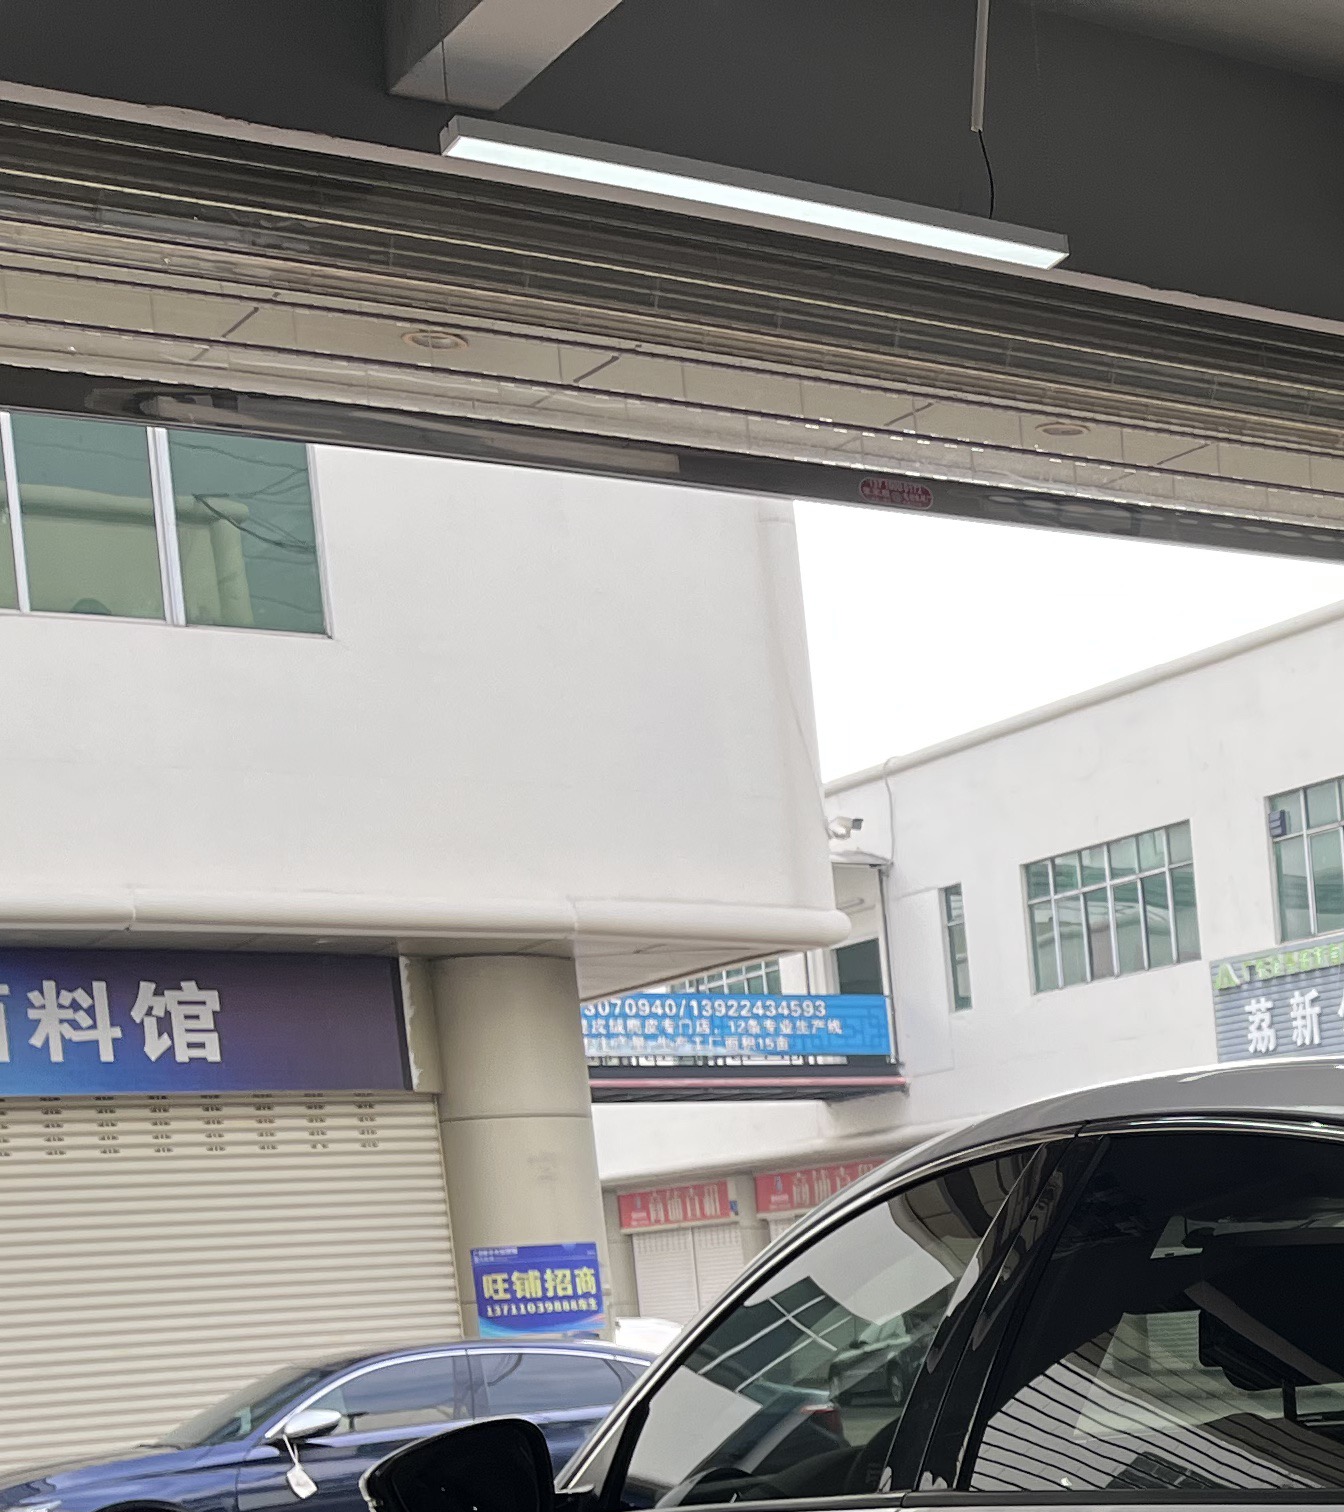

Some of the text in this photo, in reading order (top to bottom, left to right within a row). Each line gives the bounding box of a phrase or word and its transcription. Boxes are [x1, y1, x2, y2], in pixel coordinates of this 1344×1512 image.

[0, 979, 222, 1064] 料馆
[482, 1266, 598, 1300] 旺铺招商
